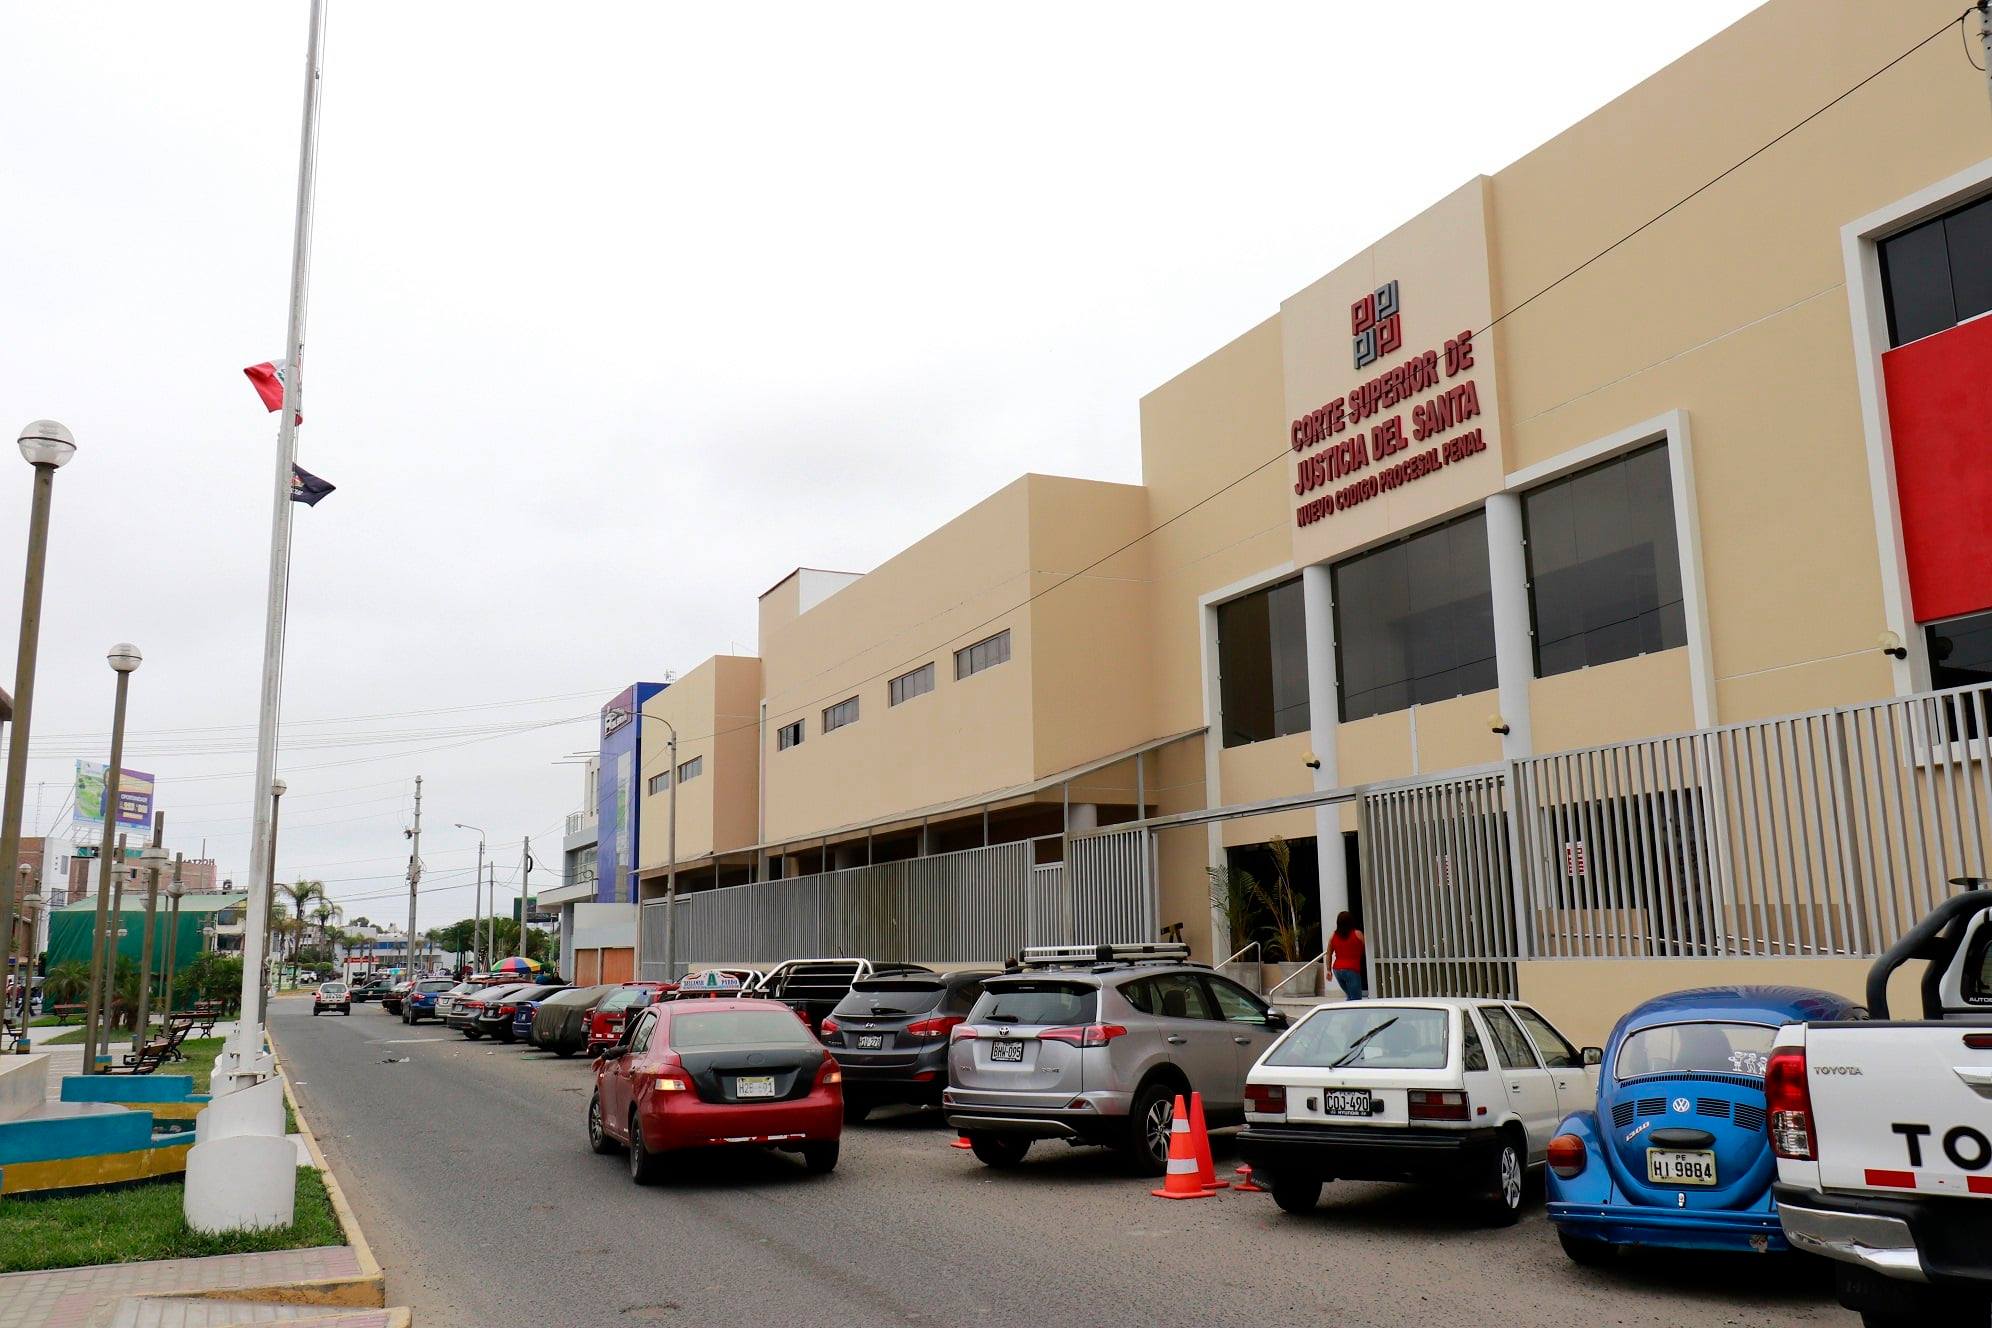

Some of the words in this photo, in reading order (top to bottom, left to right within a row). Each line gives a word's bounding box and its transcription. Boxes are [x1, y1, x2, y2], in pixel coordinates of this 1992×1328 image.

[1291, 397, 1345, 452] CORTE
[1348, 350, 1439, 424] SUPERIOR
[1444, 330, 1474, 377] DE
[1294, 433, 1369, 496] JUSTICIA
[1371, 415, 1408, 461] DEL
[1412, 380, 1480, 441] SANTA
[1297, 495, 1334, 527] NUEVO
[1335, 475, 1378, 511] CODIGO
[1379, 447, 1442, 493] PROCESAL
[1442, 428, 1486, 465] PENAL
[1814, 1066, 1863, 1076] TOYOTA
